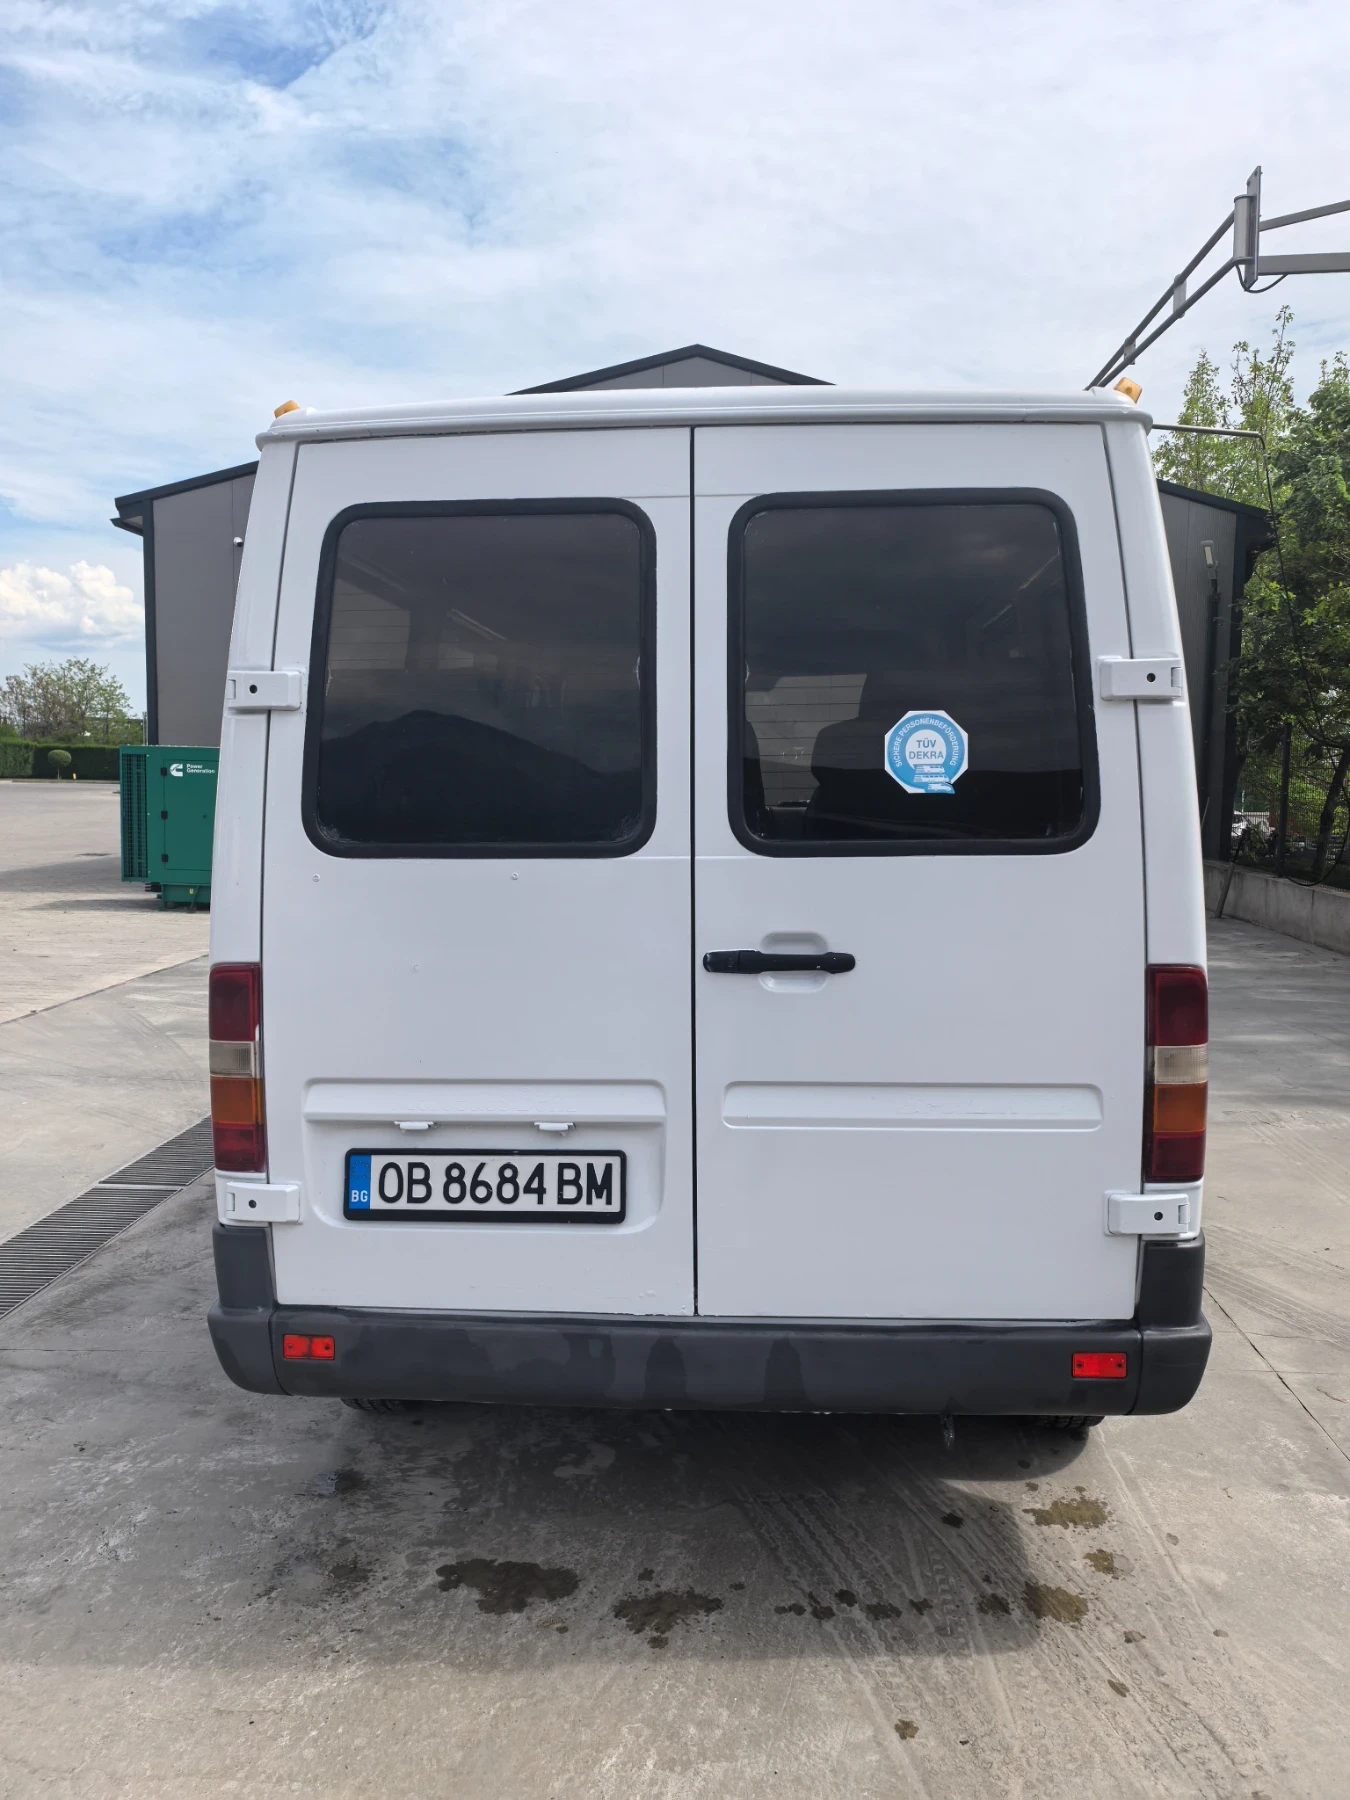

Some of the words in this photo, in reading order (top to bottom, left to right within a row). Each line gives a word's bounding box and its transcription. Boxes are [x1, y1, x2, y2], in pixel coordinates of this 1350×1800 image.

[893, 736, 903, 768] SICHERE
[899, 717, 959, 766] PERSONENBEFÖRDERUNG
[916, 737, 937, 748] TÜV
[909, 751, 944, 760] DEKRA
[378, 1162, 432, 1204] OB
[443, 1162, 546, 1204] 8684
[557, 1162, 613, 1205] BM
[351, 1190, 368, 1202] BG
